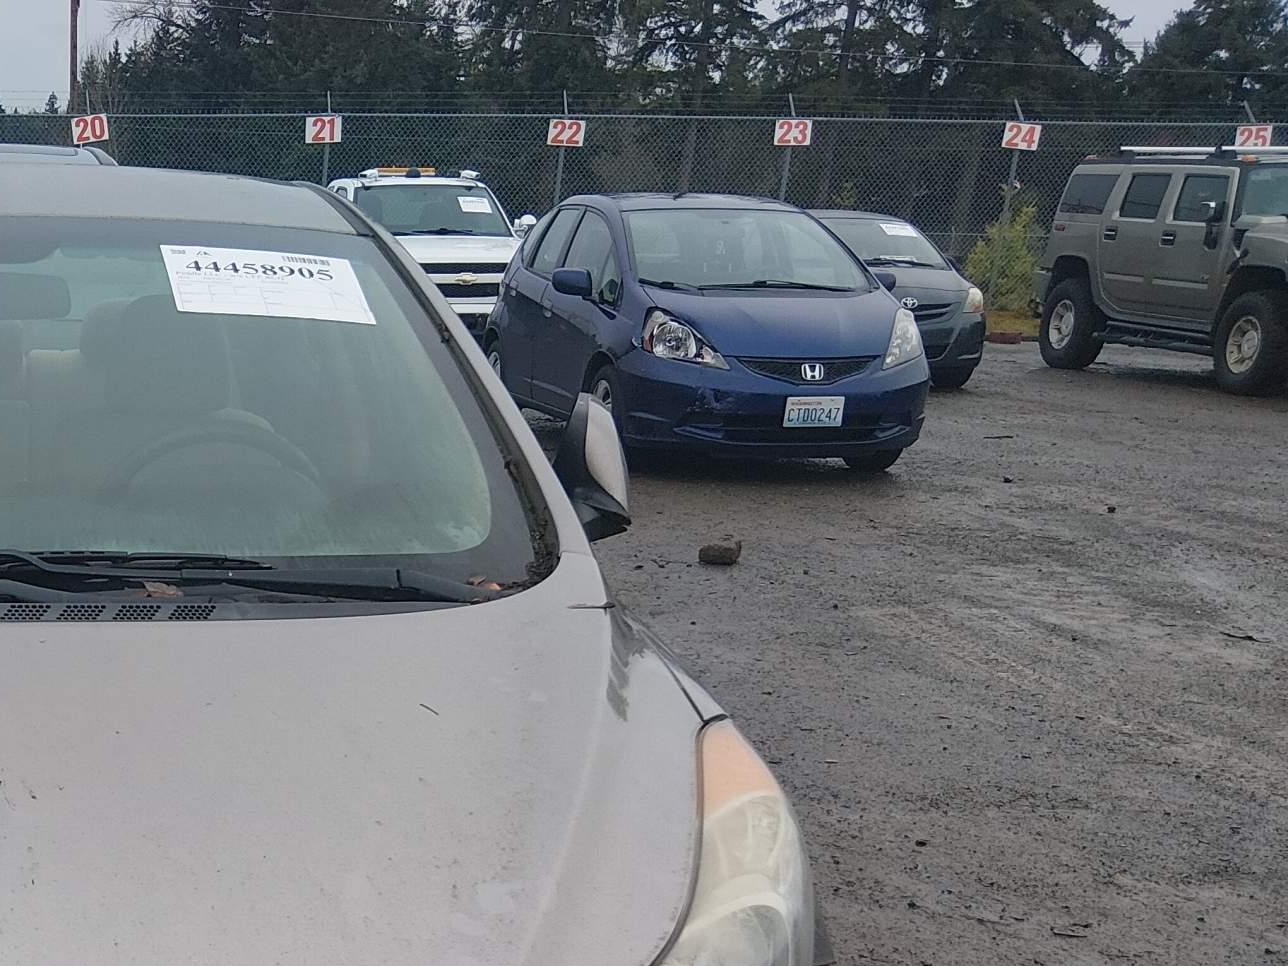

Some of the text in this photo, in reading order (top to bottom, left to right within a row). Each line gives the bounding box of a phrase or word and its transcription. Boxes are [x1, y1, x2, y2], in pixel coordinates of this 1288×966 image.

[75, 116, 105, 142] 20
[311, 118, 336, 142] 21
[551, 120, 582, 145] 22
[777, 120, 809, 144] 23
[1004, 124, 1036, 148] 24
[1239, 127, 1269, 146] 25
[186, 259, 334, 281] 44458905
[787, 407, 840, 423] CTD0247
